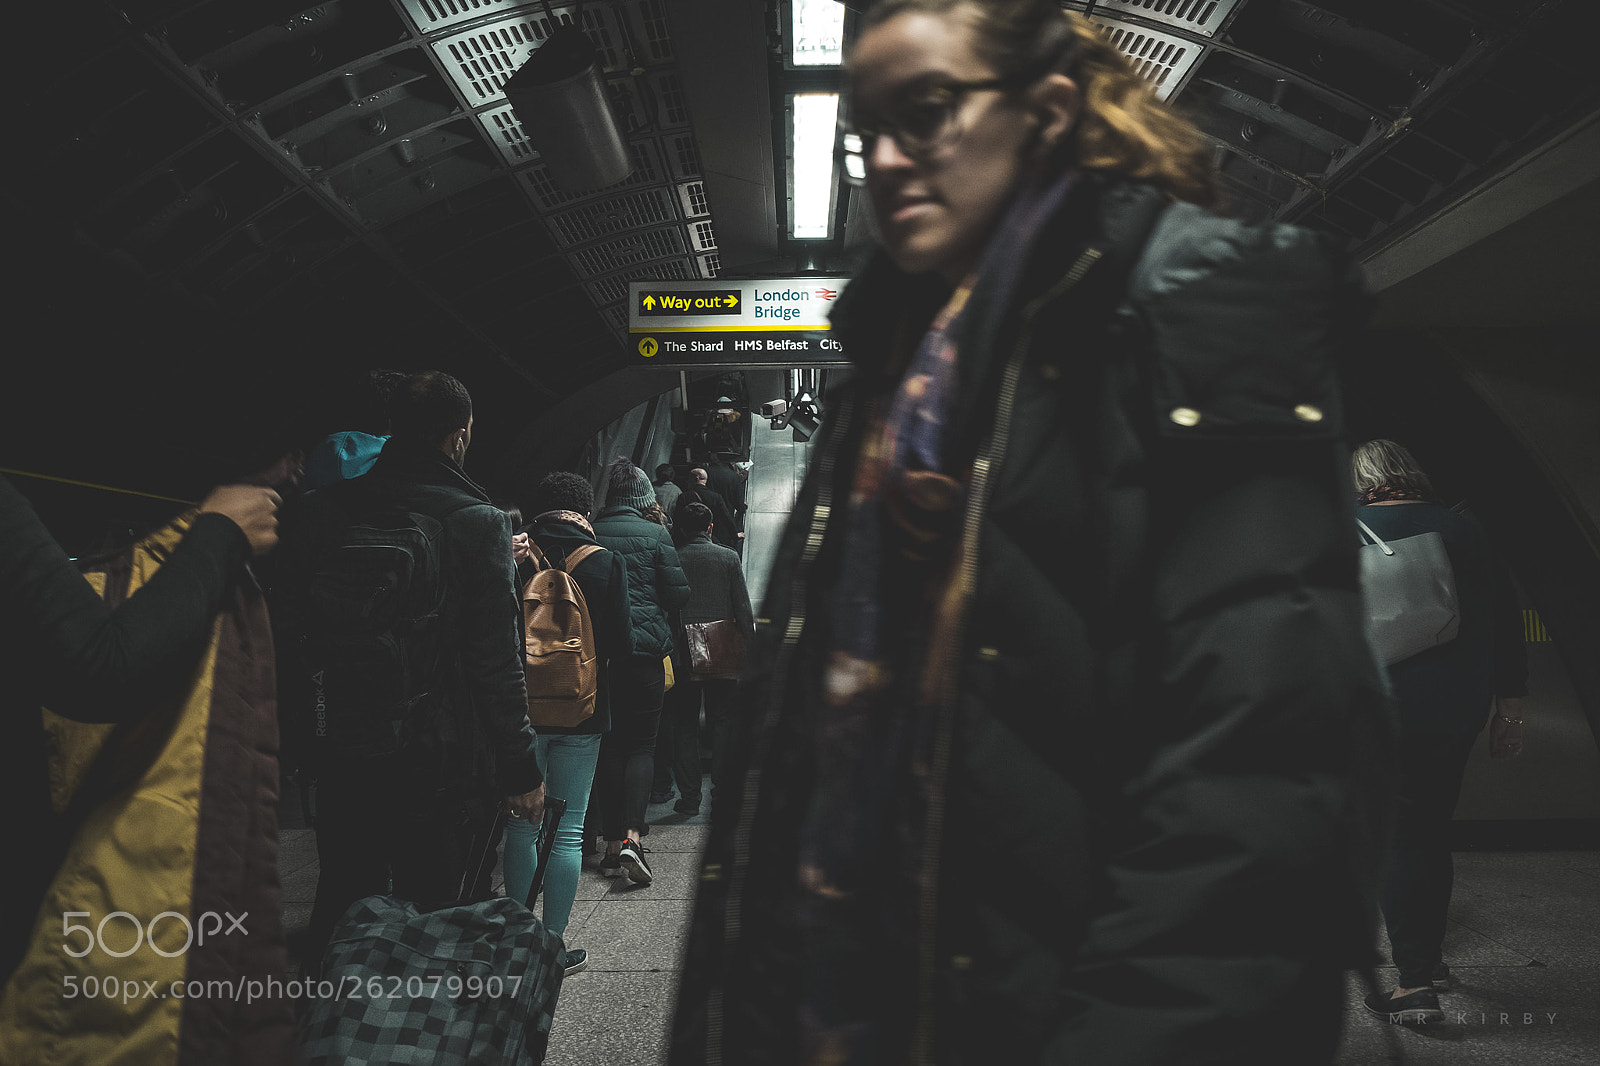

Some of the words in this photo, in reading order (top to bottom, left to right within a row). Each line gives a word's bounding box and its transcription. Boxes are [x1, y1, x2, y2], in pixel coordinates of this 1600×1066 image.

[754, 289, 809, 302] London
[660, 295, 692, 312] Way
[695, 296, 722, 309] out
[754, 306, 801, 321] Bridge
[664, 341, 687, 352] The
[690, 340, 724, 352] Shard
[734, 340, 763, 351] HMS
[766, 339, 808, 351] Belfast
[316, 687, 326, 737] Reebok
